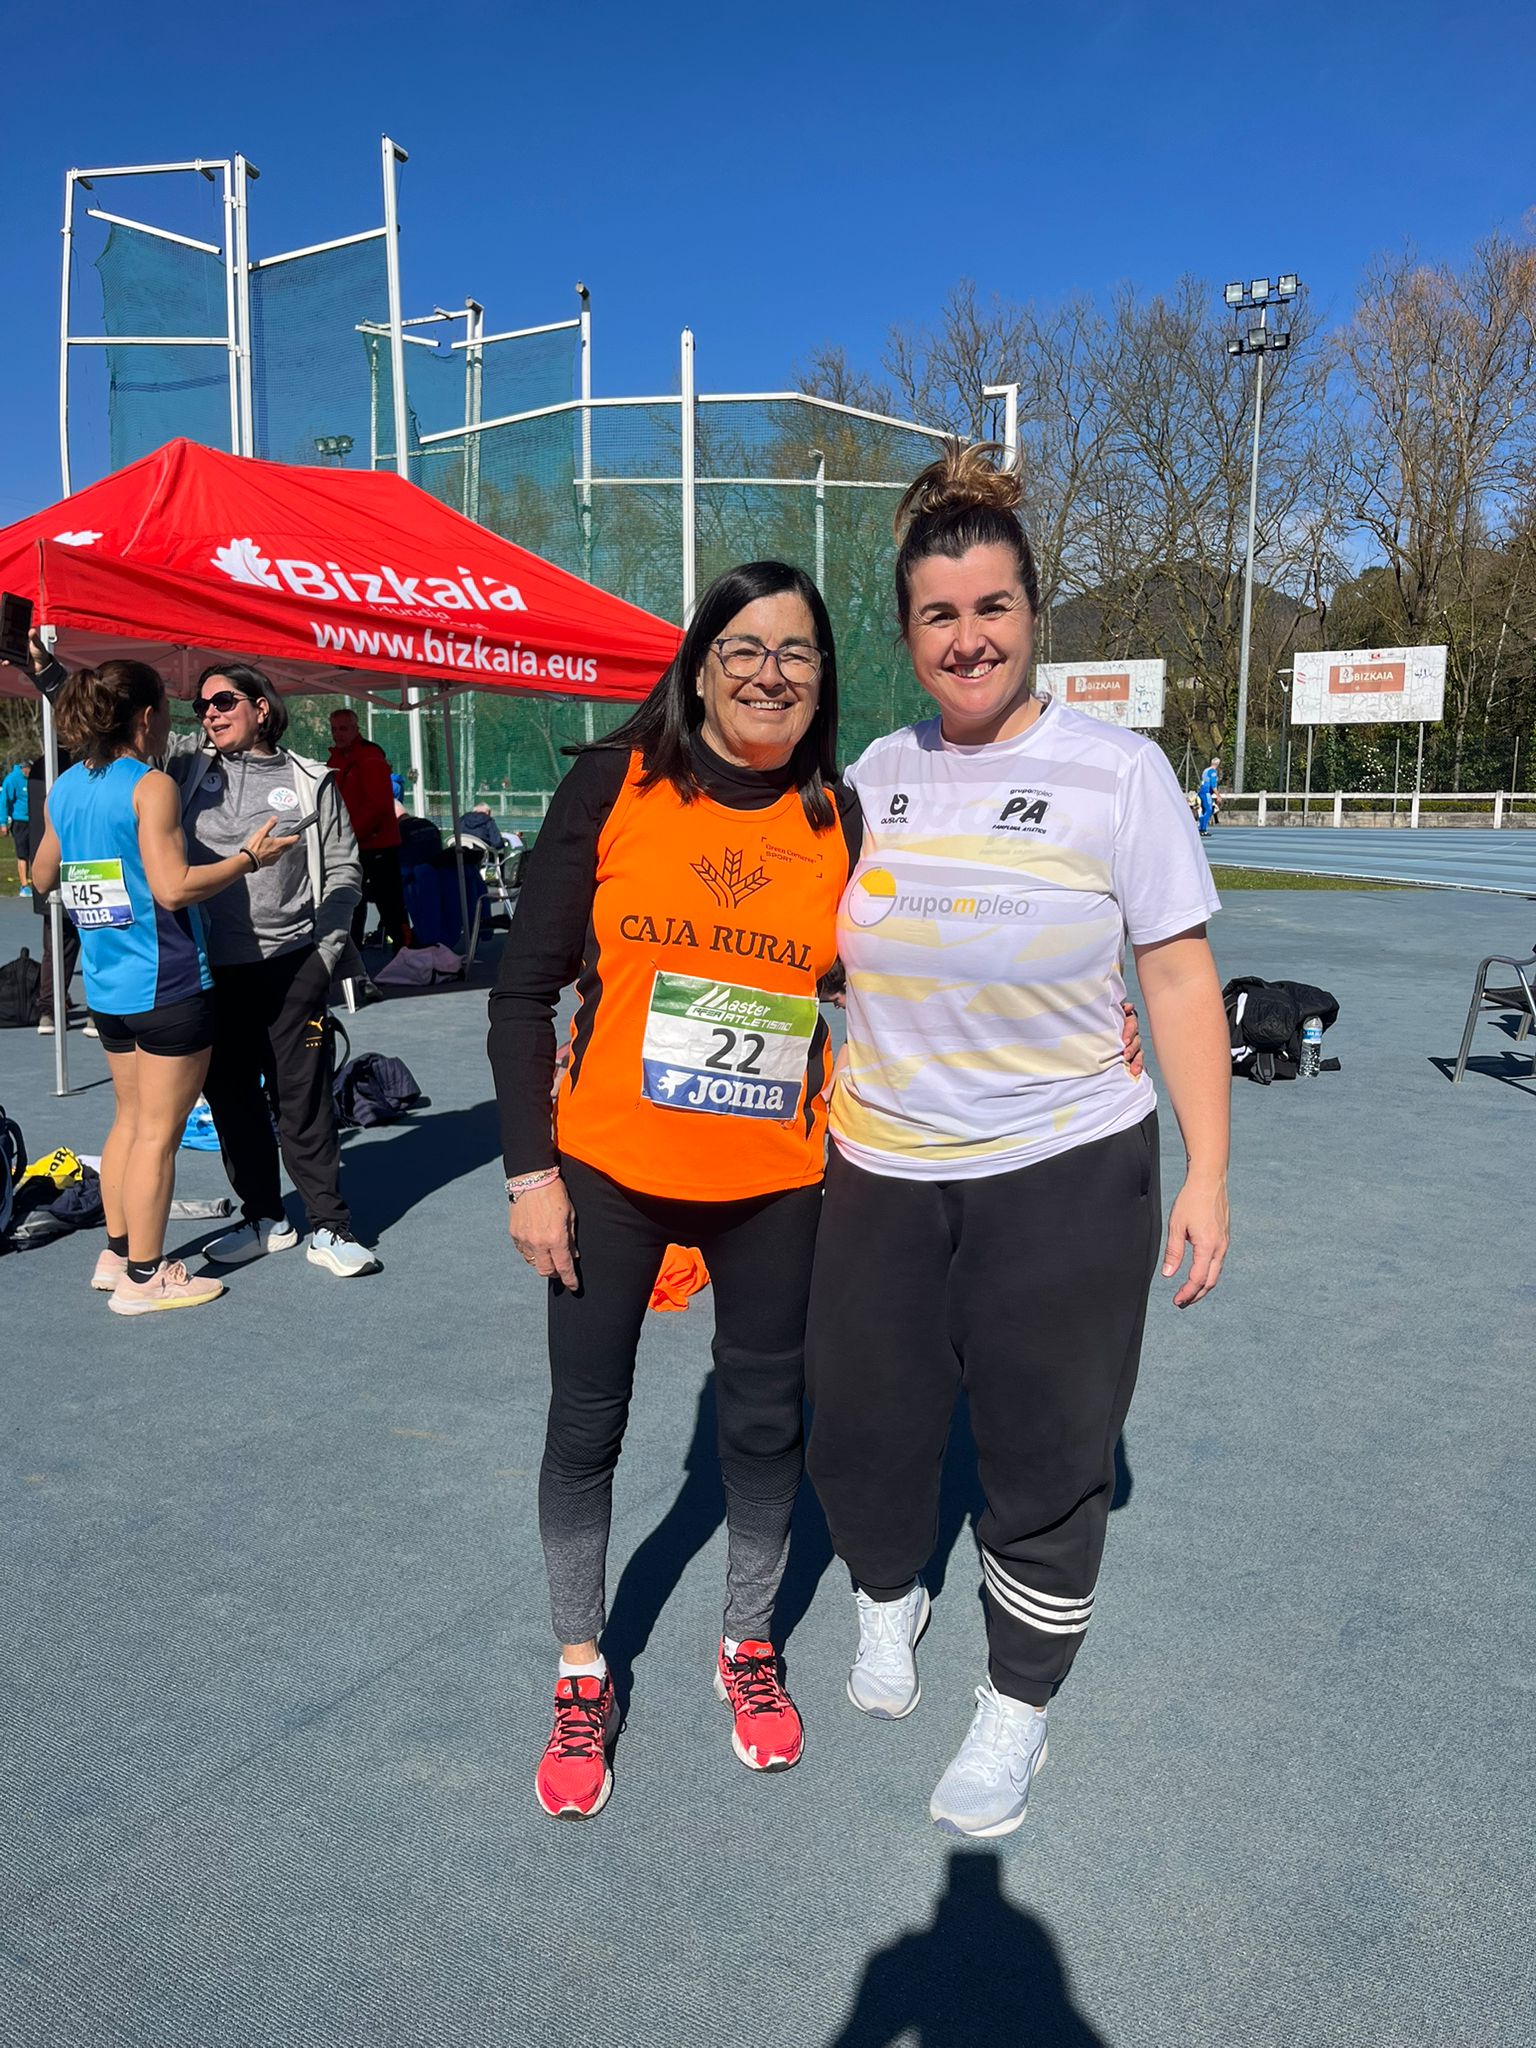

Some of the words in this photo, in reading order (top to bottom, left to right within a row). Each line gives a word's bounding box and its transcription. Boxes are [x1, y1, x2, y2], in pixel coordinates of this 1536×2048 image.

[276, 558, 528, 613] Bizkaia
[311, 621, 598, 684] www.bizkaia.eus
[1087, 681, 1121, 690] BIZKAIA
[1354, 671, 1394, 681] BIZKAIA
[1000, 797, 1048, 824] PA
[71, 884, 104, 905] F45
[620, 915, 699, 948] CAJA
[709, 925, 813, 972] RURAL
[723, 1013, 793, 1031] ATLETISMO
[705, 1027, 766, 1076] 22
